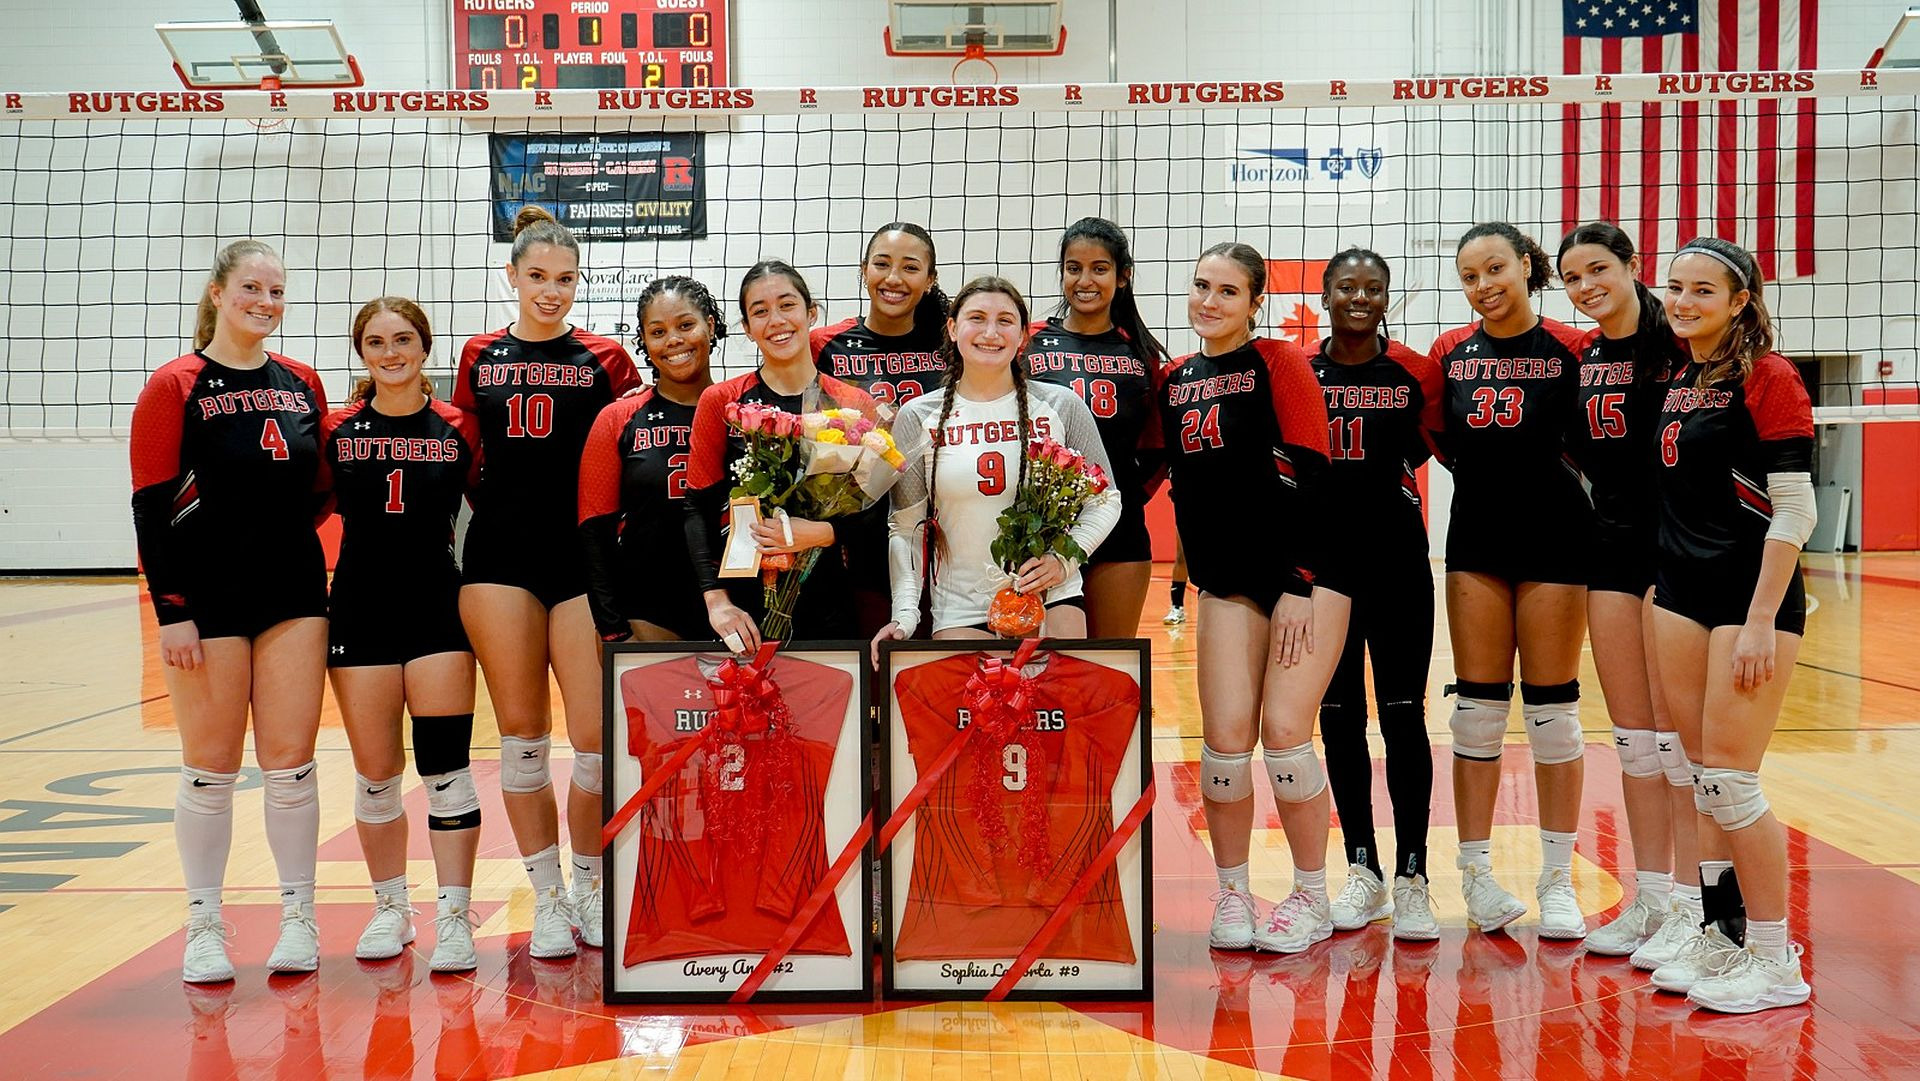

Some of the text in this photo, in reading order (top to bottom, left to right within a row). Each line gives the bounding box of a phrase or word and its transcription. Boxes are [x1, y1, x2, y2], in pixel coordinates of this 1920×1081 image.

[464, 0, 535, 10] RUTGERS
[571, 2, 609, 13] PERIOD
[656, 0, 705, 8] GUEST
[505, 16, 523, 48] 0
[592, 19, 598, 43] 1
[690, 13, 708, 46] 0
[468, 54, 502, 65] FOULS
[514, 54, 543, 64] T.O.L.
[554, 52, 628, 64] PLAYER FOUL
[638, 52, 668, 63] T.O.L.
[680, 51, 713, 63] FOULS
[1128, 82, 1284, 103] RUTGERS
[1393, 76, 1549, 99] RUTGERS
[1658, 72, 1815, 94] RUTGERS
[69, 93, 225, 112] RUTGERS
[333, 91, 489, 112] RUTGERS
[598, 89, 754, 110] RUTGERS
[863, 86, 1019, 107] RUTGERS
[1232, 163, 1310, 181] Horizon
[570, 203, 633, 219] FAIRNESS
[636, 201, 692, 217] CIVILITY
[478, 363, 594, 387] RUTGERS
[832, 350, 947, 377] RUTGERS
[1028, 351, 1145, 376] RUTGERS
[1448, 357, 1562, 380] RUTGERS
[1169, 369, 1255, 406] RUTGERS
[1320, 386, 1410, 408] TGERS
[198, 389, 310, 420] RUTGERS
[506, 393, 553, 438] 10
[1467, 386, 1524, 428] 33
[1586, 393, 1627, 439] 15
[260, 418, 289, 460] 4
[1181, 403, 1224, 454] 24
[1328, 416, 1365, 460] 11
[336, 438, 459, 462] RUTGERS
[1661, 420, 1682, 467] 8
[977, 451, 1006, 496] 9
[386, 468, 404, 513] 1
[720, 744, 745, 791] 2
[1002, 744, 1027, 791] 9
[683, 960, 729, 983] Avery
[940, 961, 1080, 984] Sophia Laorta #9
